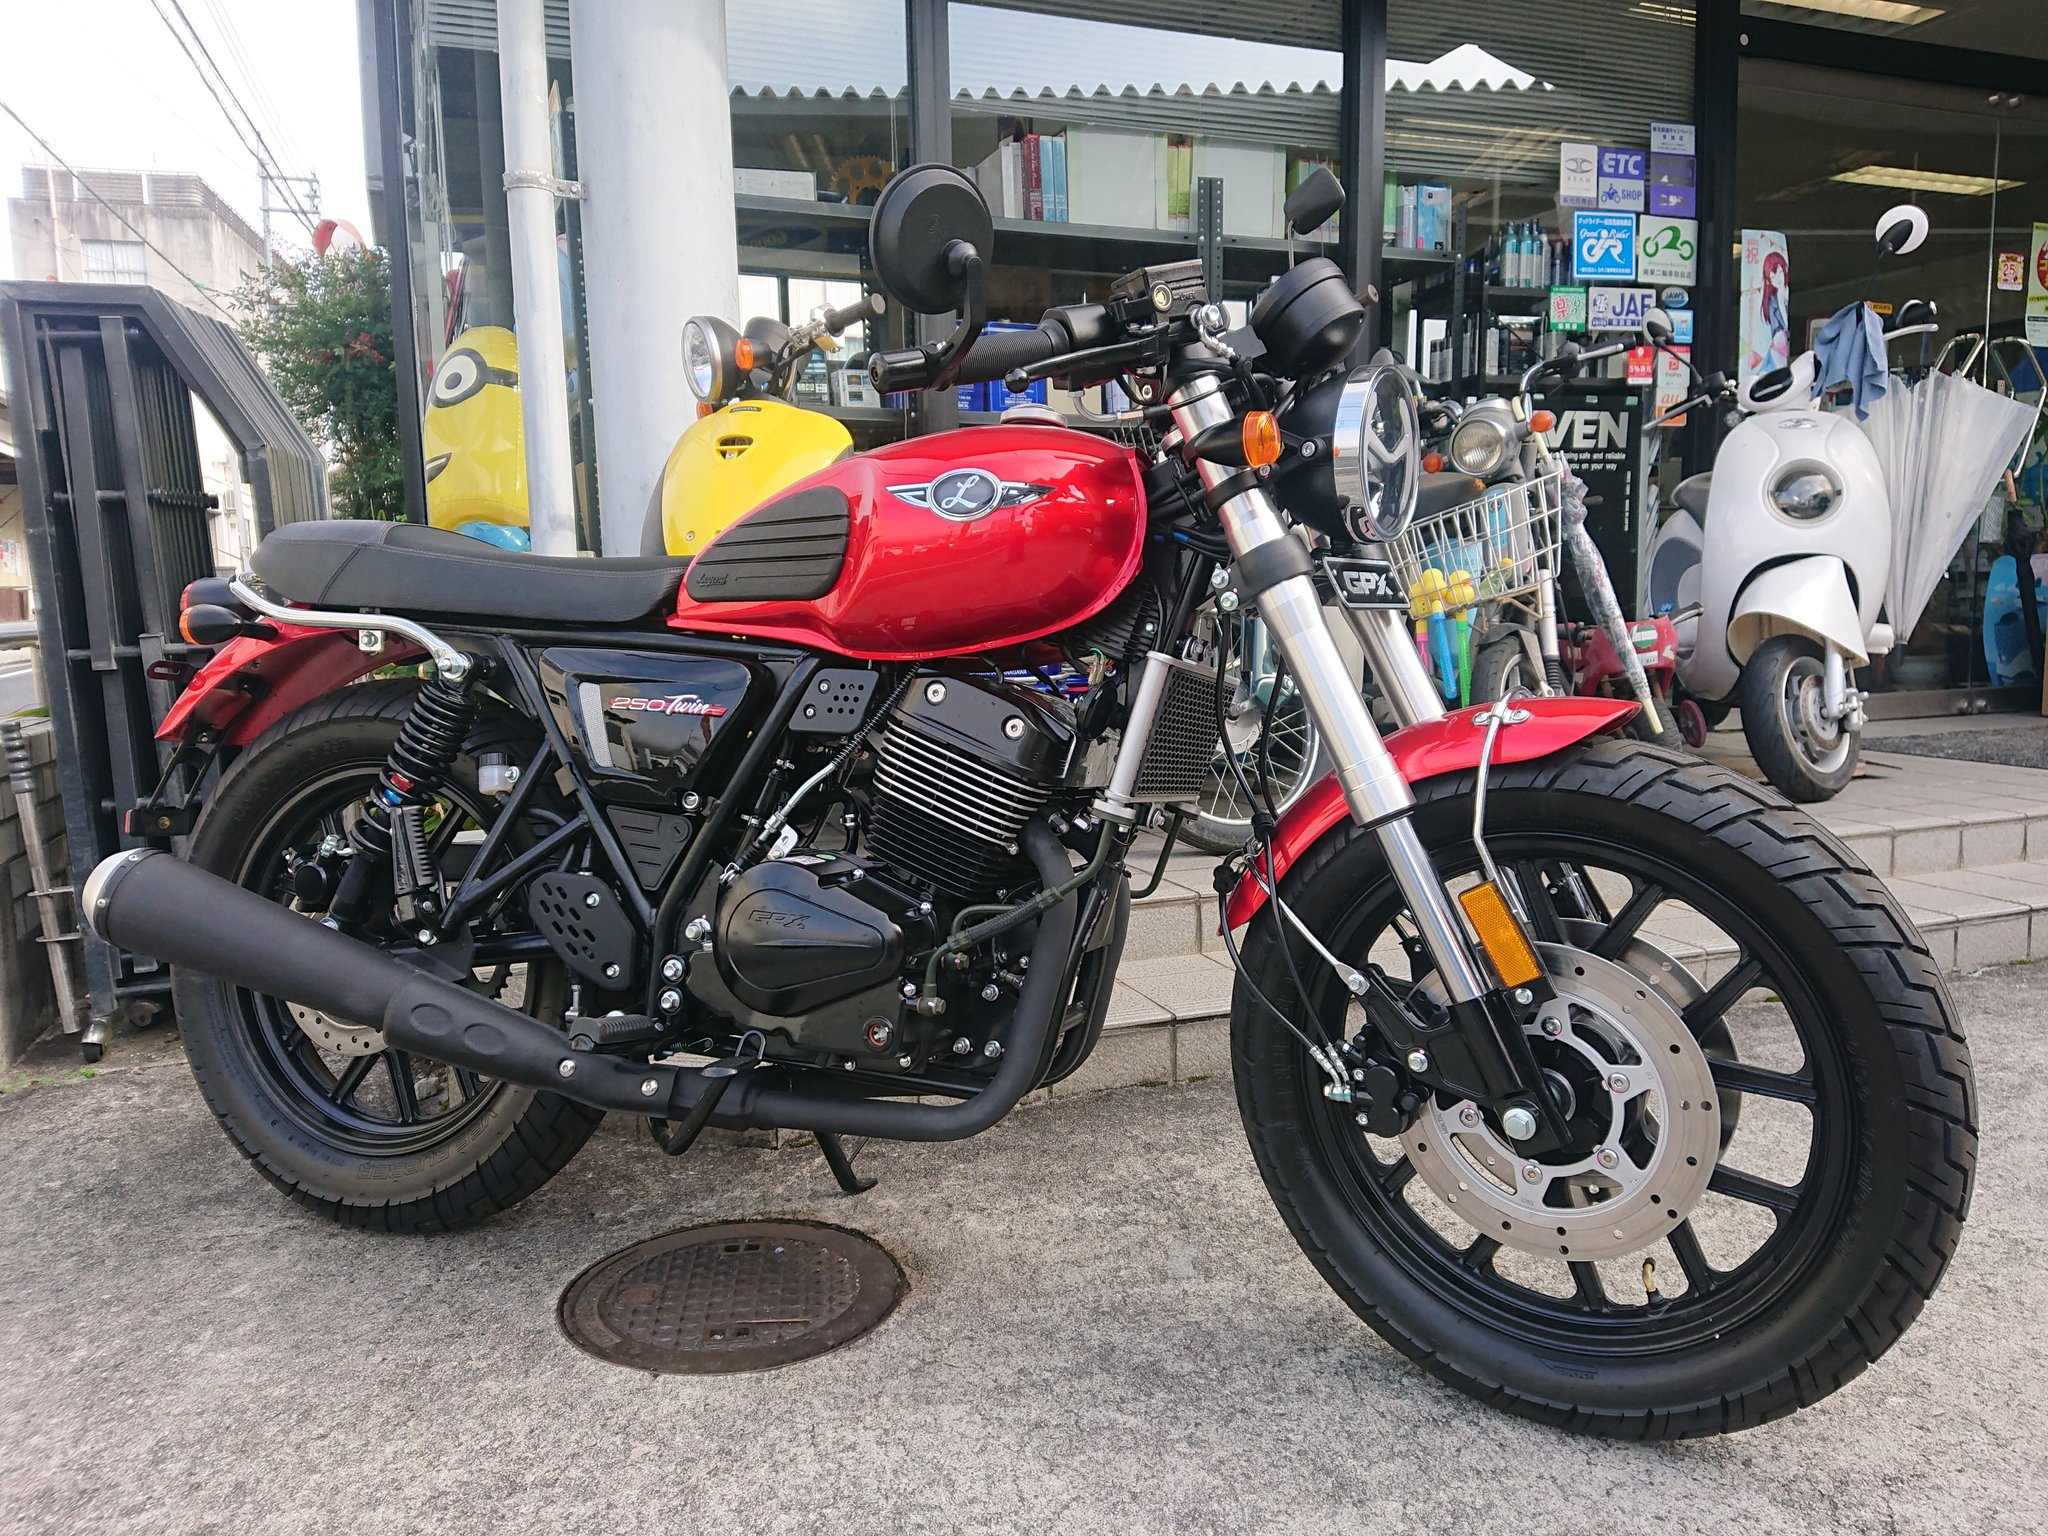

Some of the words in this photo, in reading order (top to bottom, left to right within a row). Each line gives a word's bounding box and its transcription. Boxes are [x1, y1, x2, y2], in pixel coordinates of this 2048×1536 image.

[1602, 152, 1642, 176] ETC
[1621, 189, 1642, 201] SHOP
[1661, 393, 1680, 404] au
[1579, 451, 1590, 459] safe
[1605, 452, 1626, 460] reliable
[1606, 463, 1617, 471] way
[1343, 571, 1393, 595] GPX
[611, 697, 665, 711] 250
[664, 694, 711, 715] Twin
[357, 1147, 450, 1181] RUBBER
